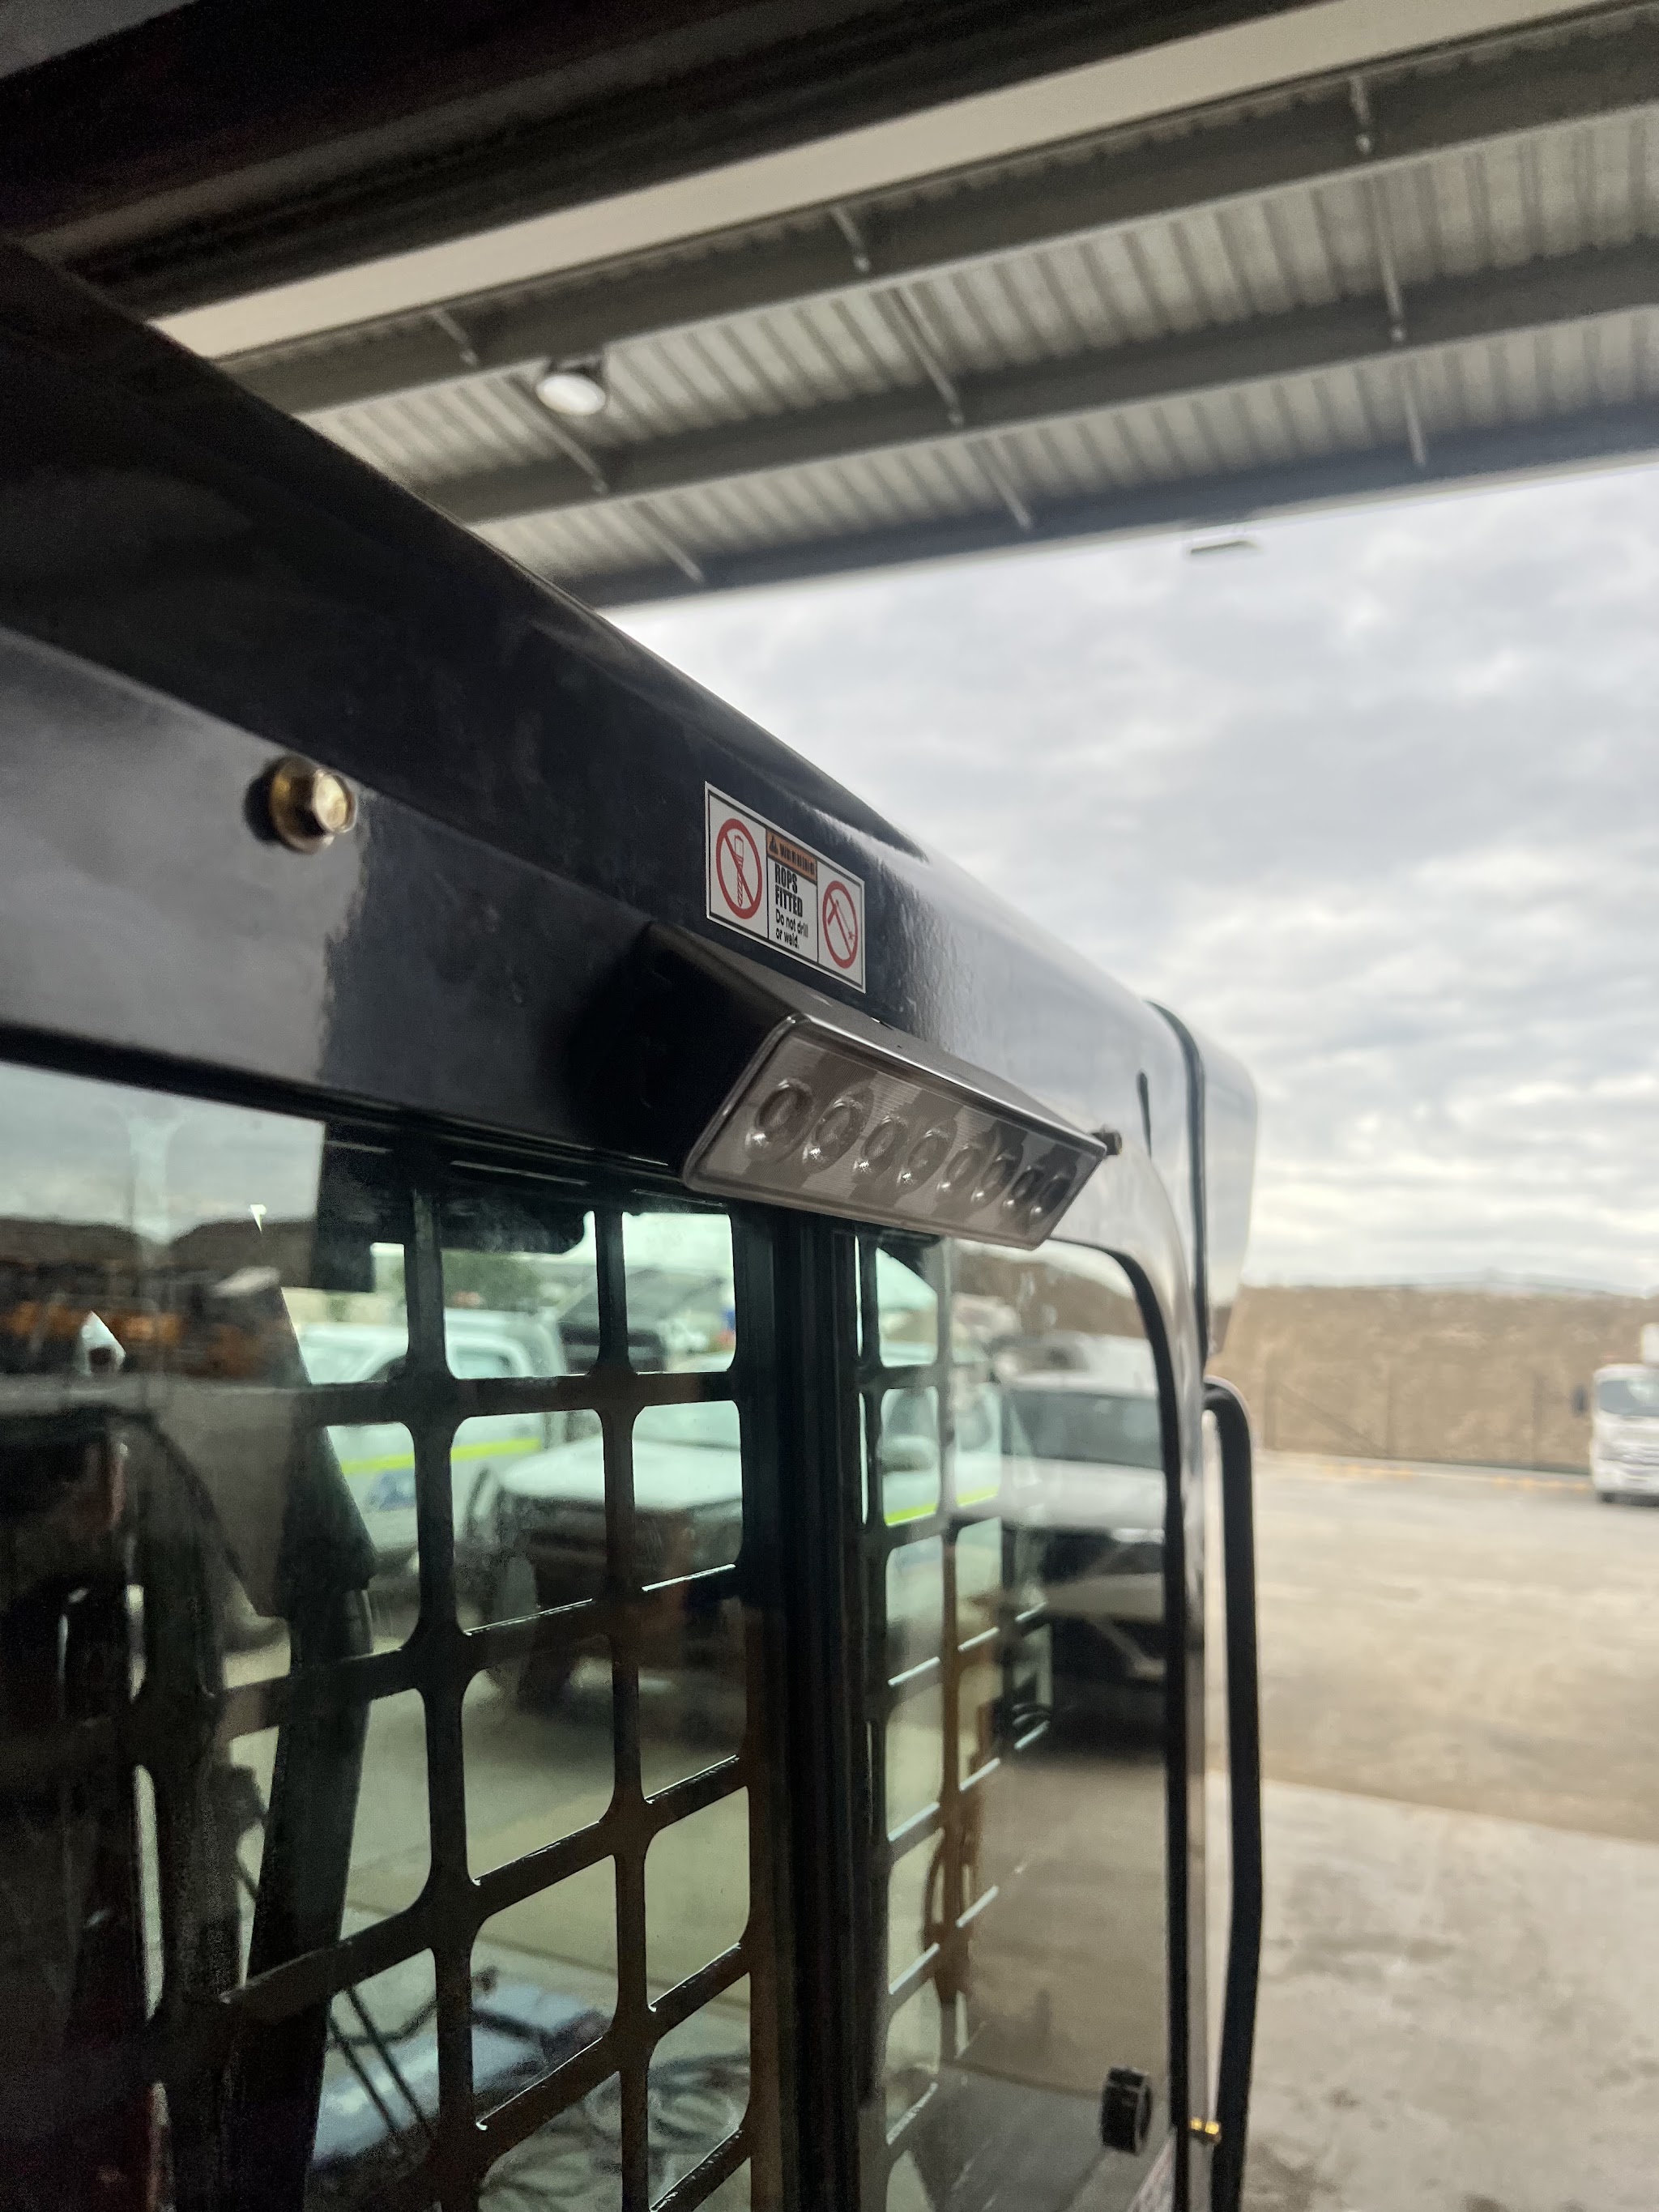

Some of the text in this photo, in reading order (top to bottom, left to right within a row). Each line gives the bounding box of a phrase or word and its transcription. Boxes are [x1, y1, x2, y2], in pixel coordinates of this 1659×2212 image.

[775, 862, 797, 893] ROPS
[775, 885, 803, 918] FITTED
[776, 908, 808, 938] Do not drill
[776, 927, 783, 940] or
